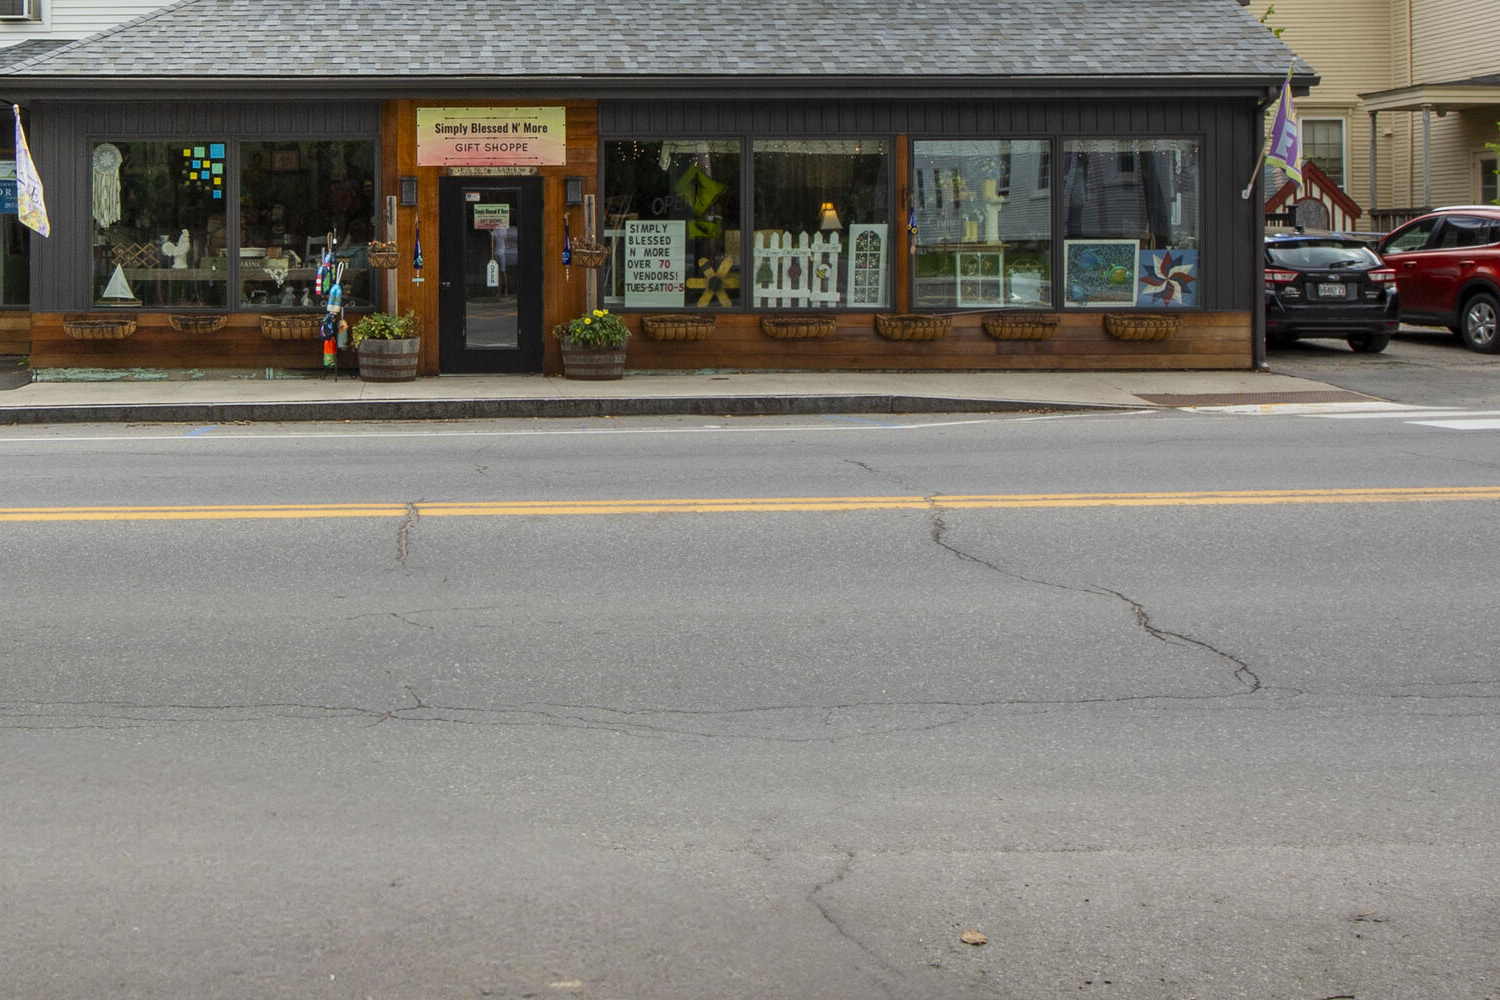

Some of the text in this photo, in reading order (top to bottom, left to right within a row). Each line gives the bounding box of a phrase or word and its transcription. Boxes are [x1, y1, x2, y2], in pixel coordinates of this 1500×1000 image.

[435, 123, 468, 135] Simply
[471, 123, 509, 134] Blessed
[524, 122, 548, 133] More
[455, 143, 529, 152] GIFT SHOPPE
[629, 224, 668, 233] SIMPLY
[628, 236, 672, 245] BLESSED
[629, 248, 670, 257] N MORE
[627, 260, 671, 269] OVER 70
[633, 272, 678, 280] VENDORS!
